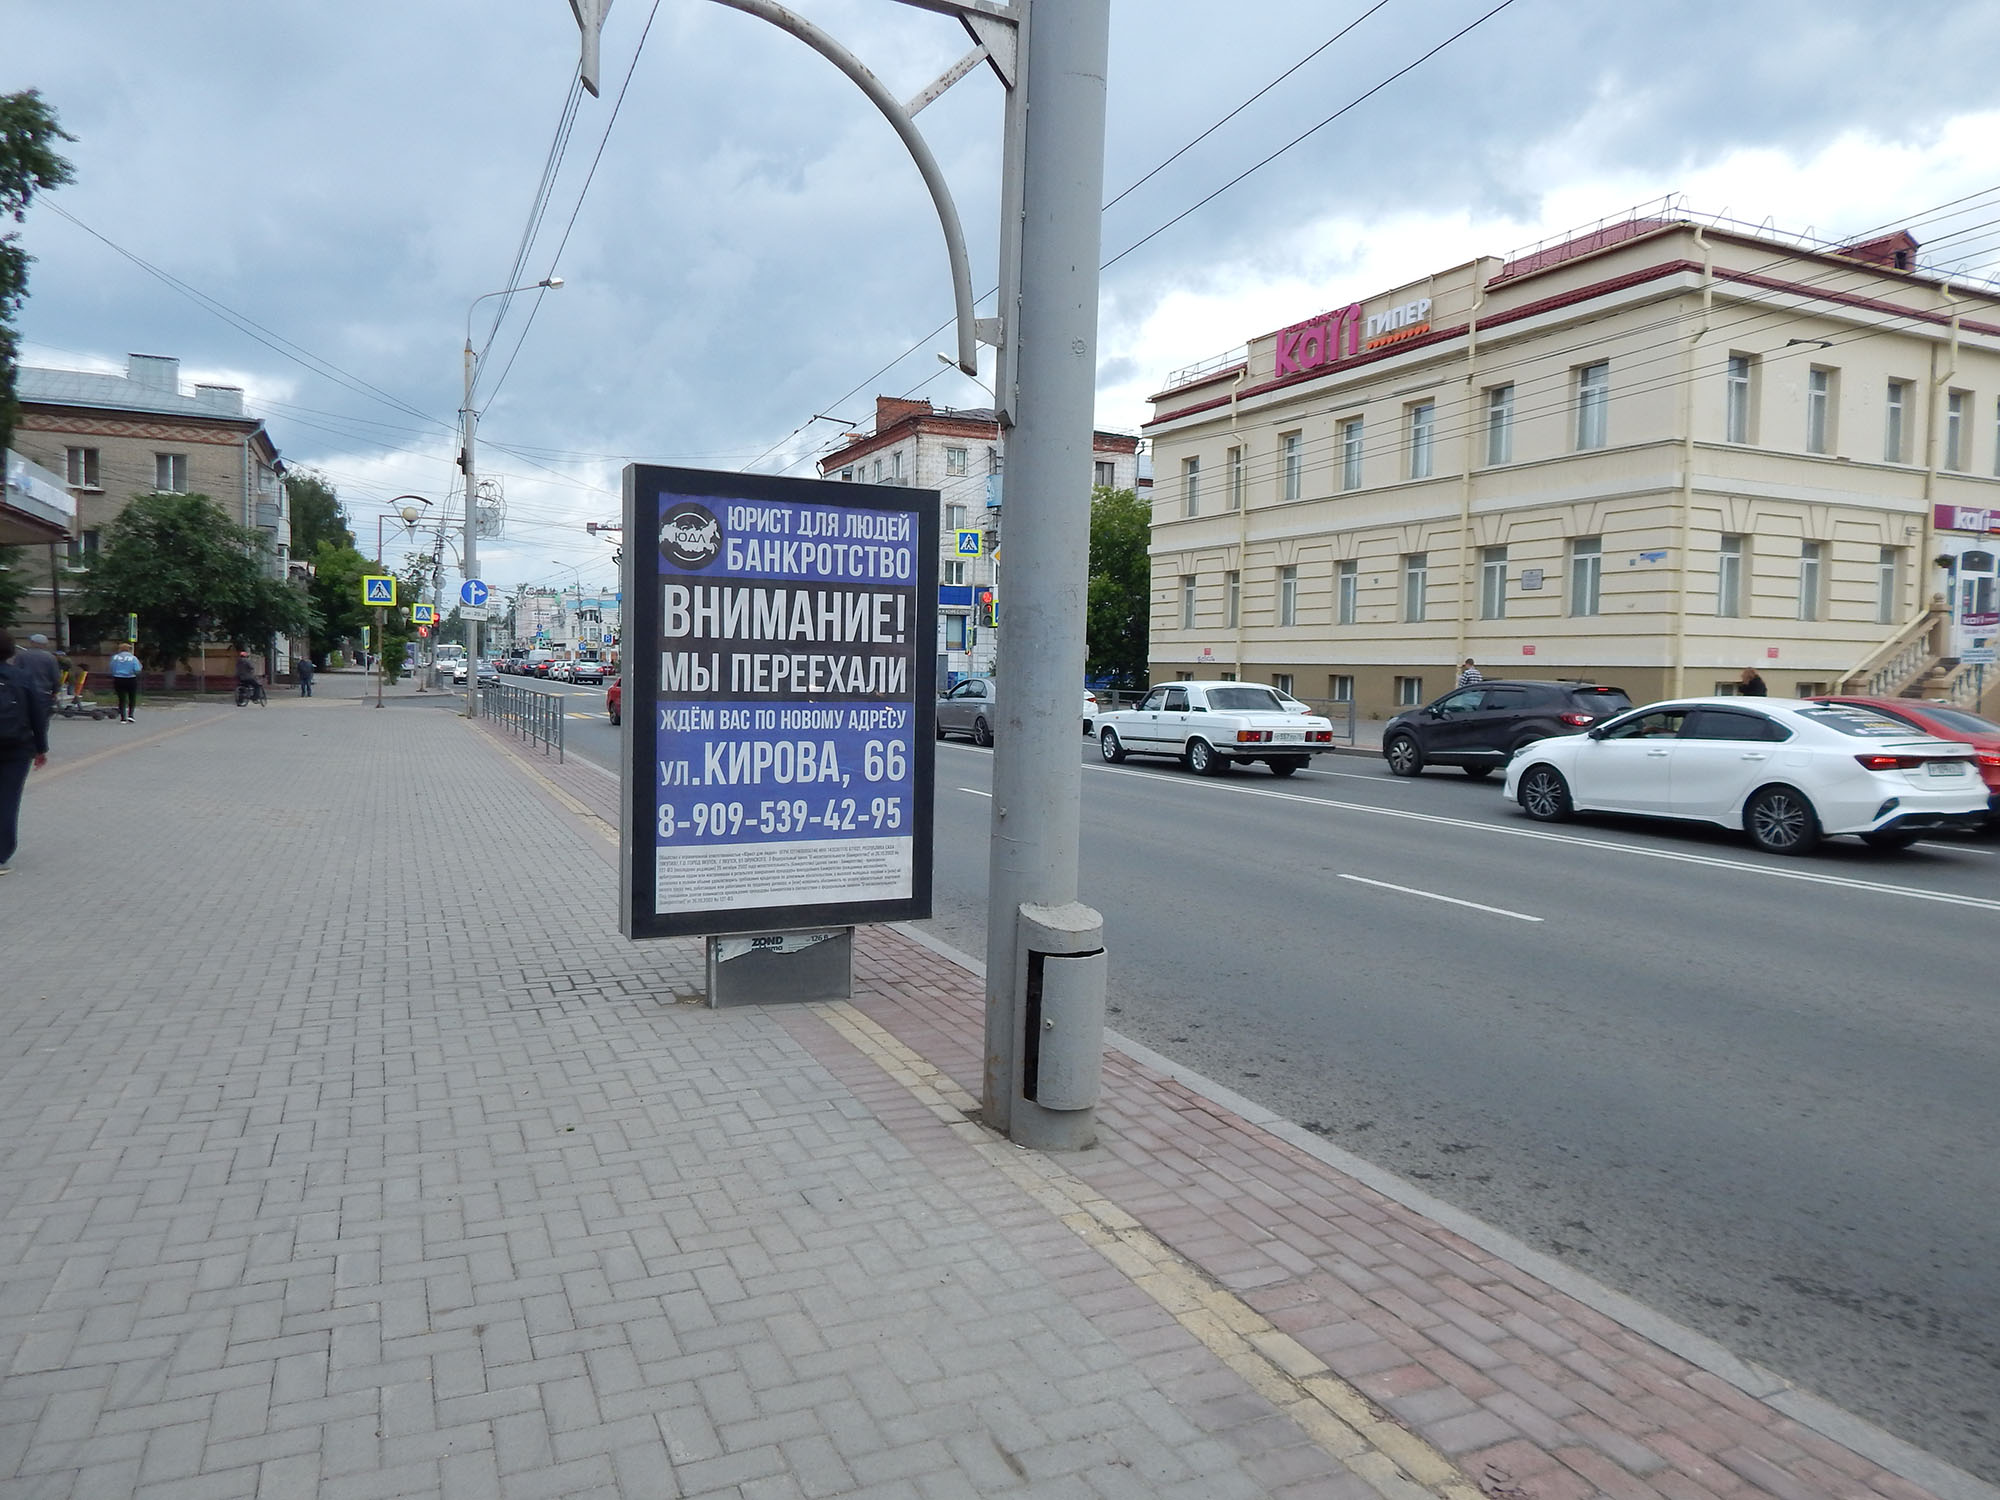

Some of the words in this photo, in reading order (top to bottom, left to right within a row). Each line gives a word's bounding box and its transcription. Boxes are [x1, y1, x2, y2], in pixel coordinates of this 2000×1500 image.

[1366, 298, 1432, 338] ГИПЕР
[1274, 303, 1361, 377] kari
[674, 532, 706, 543] ЮДЛ
[727, 505, 793, 534] ЮРИСТ
[796, 510, 839, 539] ДЛЯ
[842, 513, 910, 543] ЛЮДЕЙ
[1953, 506, 1991, 531] kari
[726, 538, 911, 580] БАНКРОТСТВО
[663, 584, 906, 644] ВНИМАНИЕ!
[661, 651, 720, 692] МЫ
[731, 653, 907, 694] ПЕРЕЕХАЛИ
[660, 706, 715, 732] ЖДЁМ
[719, 709, 751, 730] ВАС
[755, 709, 776, 730] ПО
[780, 709, 845, 730] НОВОМУ
[848, 708, 907, 732] АДРЕСУ
[864, 739, 906, 782] 66
[658, 797, 902, 838] 8-909-539-42-95
[751, 936, 784, 947] ZOND
